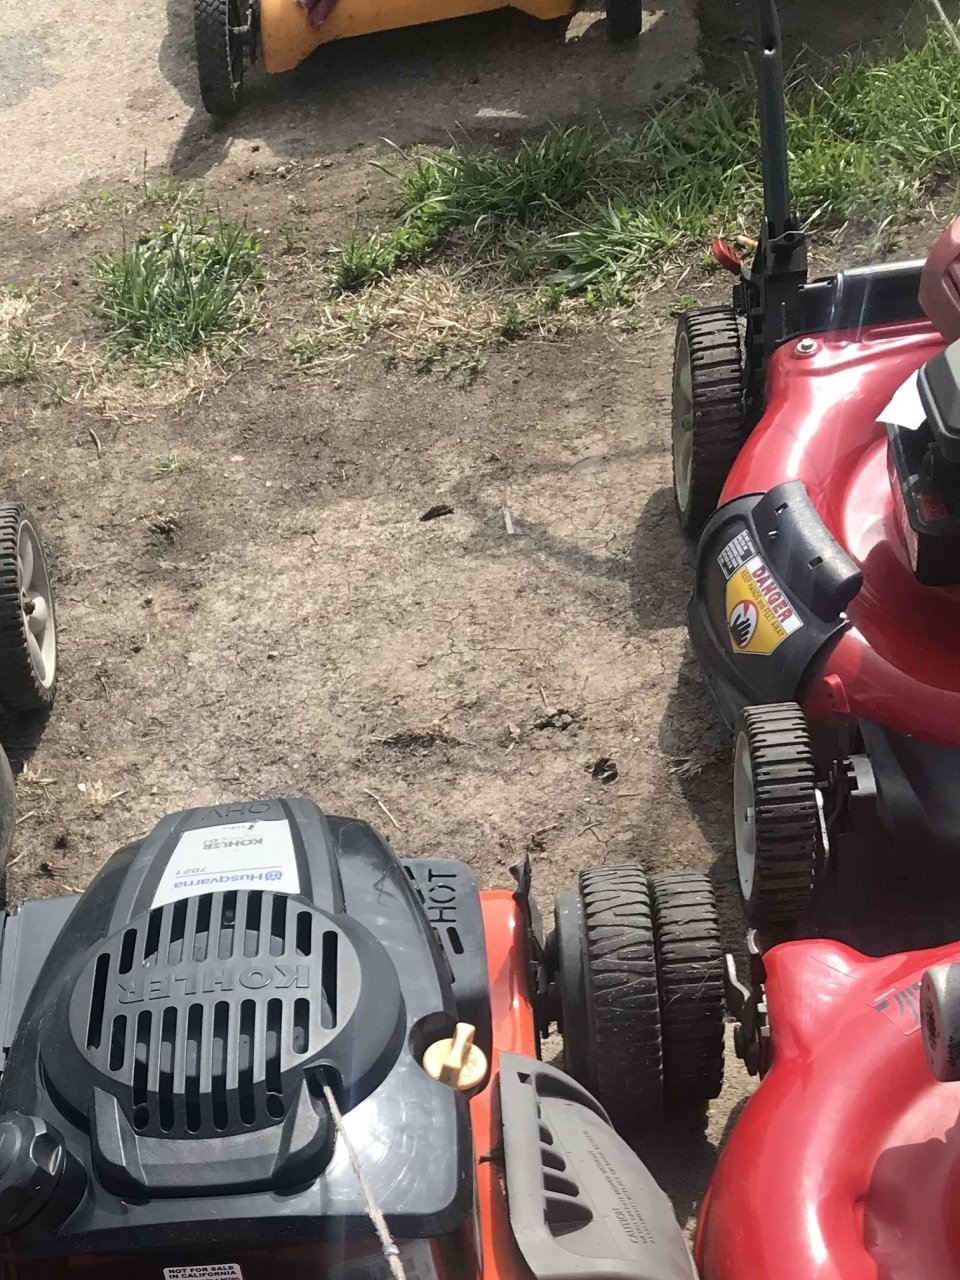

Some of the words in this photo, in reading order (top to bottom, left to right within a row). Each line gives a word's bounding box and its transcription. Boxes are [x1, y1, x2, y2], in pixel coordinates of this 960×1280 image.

[740, 570, 751, 585] KEEP
[746, 582, 762, 601] HANDS
[762, 607, 775, 622] FEET
[770, 620, 785, 638] AWAY
[751, 564, 794, 623] DANGER
[201, 803, 271, 820] OHV
[203, 838, 264, 851] KOHLER
[173, 871, 263, 889] Husqvarna
[428, 868, 457, 924] HOT
[118, 964, 310, 1004] KOHLER
[612, 1207, 639, 1244] CAUTION
[181, 1270, 237, 1279] CALIFORNIA
